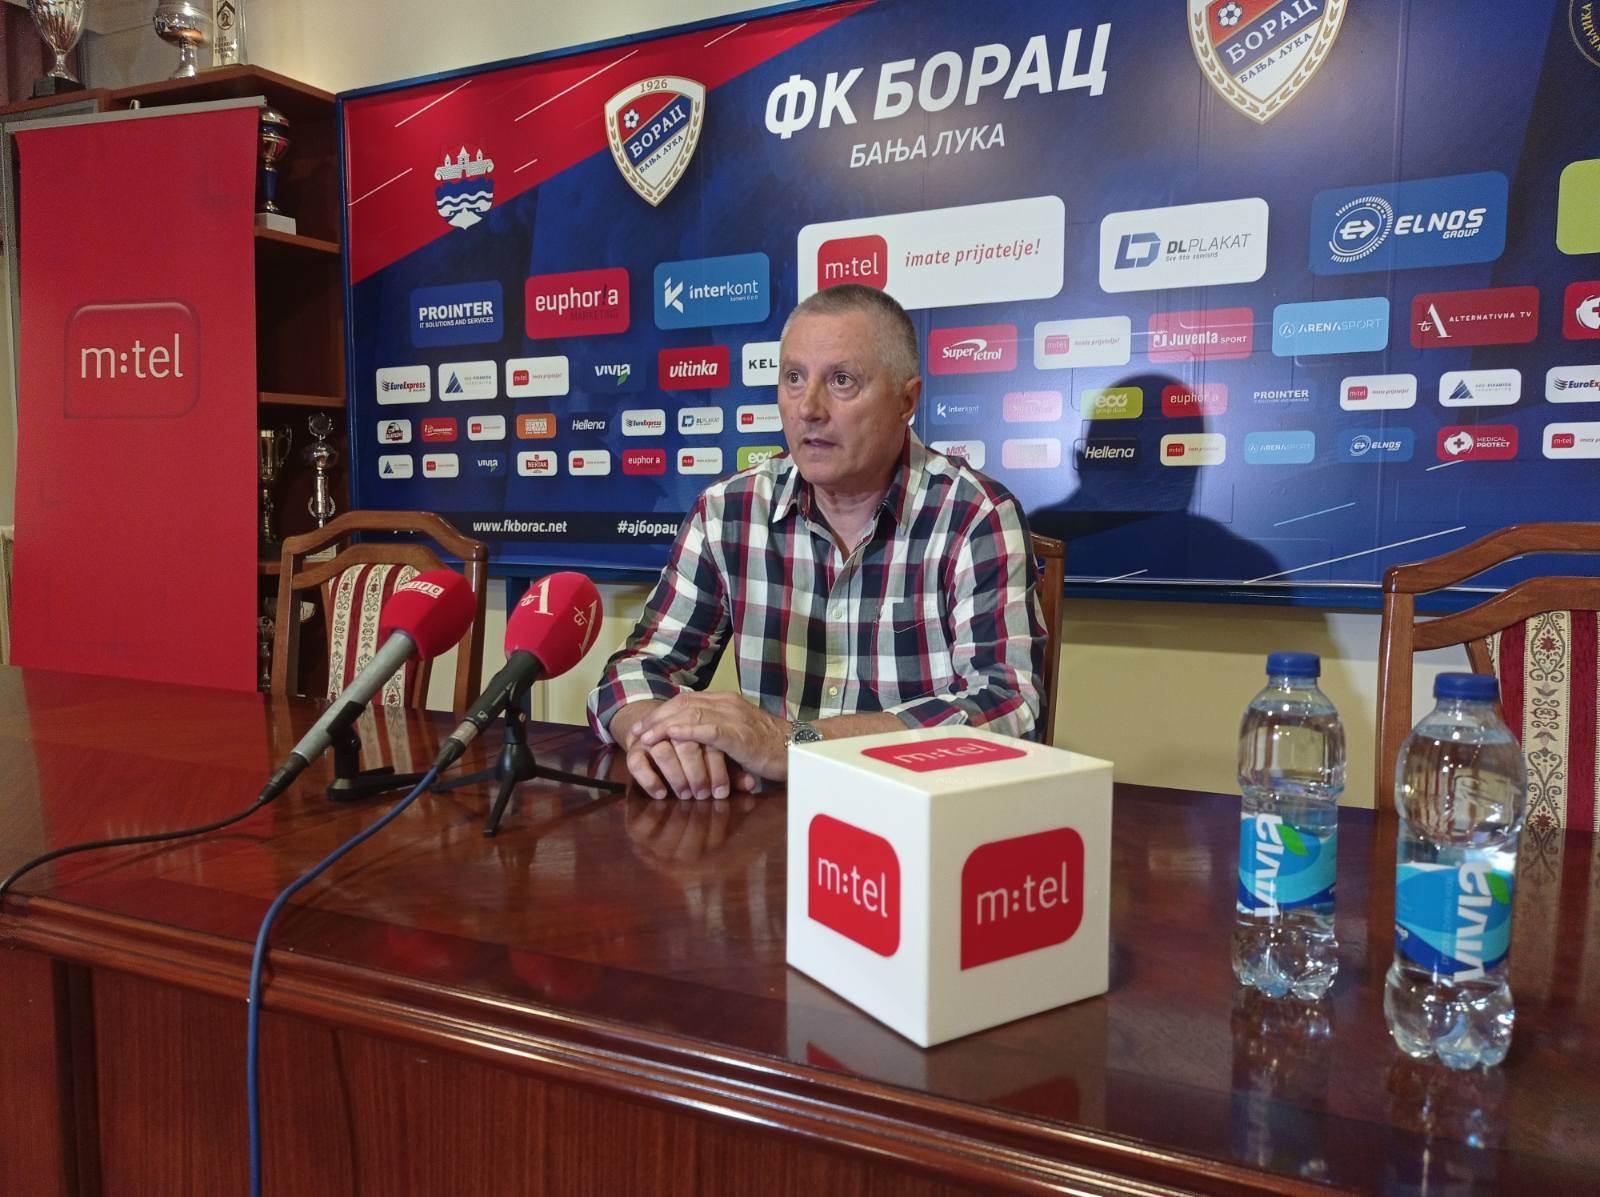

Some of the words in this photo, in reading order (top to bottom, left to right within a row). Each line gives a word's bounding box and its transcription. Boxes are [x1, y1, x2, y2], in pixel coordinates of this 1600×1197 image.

[1226, 0, 1318, 64] БОРАЦ
[1239, 57, 1275, 84] БАЊА
[1278, 33, 1312, 59] ЛУКА
[640, 79, 668, 93] 1926
[764, 67, 865, 140] ФК
[873, 23, 1112, 121] БОРАЦ
[629, 105, 686, 159] БОРАЦ
[639, 153, 662, 174] БАЊА
[662, 135, 684, 157] ЛУКА
[850, 135, 927, 169] БАЊА
[931, 123, 1005, 157] ЛУКА
[1394, 208, 1487, 235] ELNOS
[1442, 228, 1479, 239] GROUP
[905, 251, 950, 267] imate
[954, 238, 1041, 266] prijatelje!
[825, 252, 879, 279] m:tel
[535, 283, 618, 315] euphoria
[689, 280, 759, 299] interkont
[419, 301, 493, 321] PROINTER
[1449, 312, 1515, 322] ALTERNATIVNA
[425, 319, 454, 328] SOLUTIONS
[455, 318, 466, 326] AND
[1169, 331, 1218, 346] Juventa
[81, 333, 184, 379] m:tel
[748, 359, 778, 370] KEL
[669, 360, 718, 378] vitinka
[390, 381, 426, 393] EuroExpress
[1253, 389, 1310, 399] PROINTER
[572, 419, 606, 431] Hellena
[1085, 445, 1135, 459] Hellena
[1371, 441, 1402, 449] ELNOS
[628, 455, 661, 465] euphora
[473, 520, 568, 533] www.fkborac.net
[894, 742, 1001, 764] m:tel
[818, 856, 888, 919] m:tel
[976, 860, 1070, 926] m:tel
